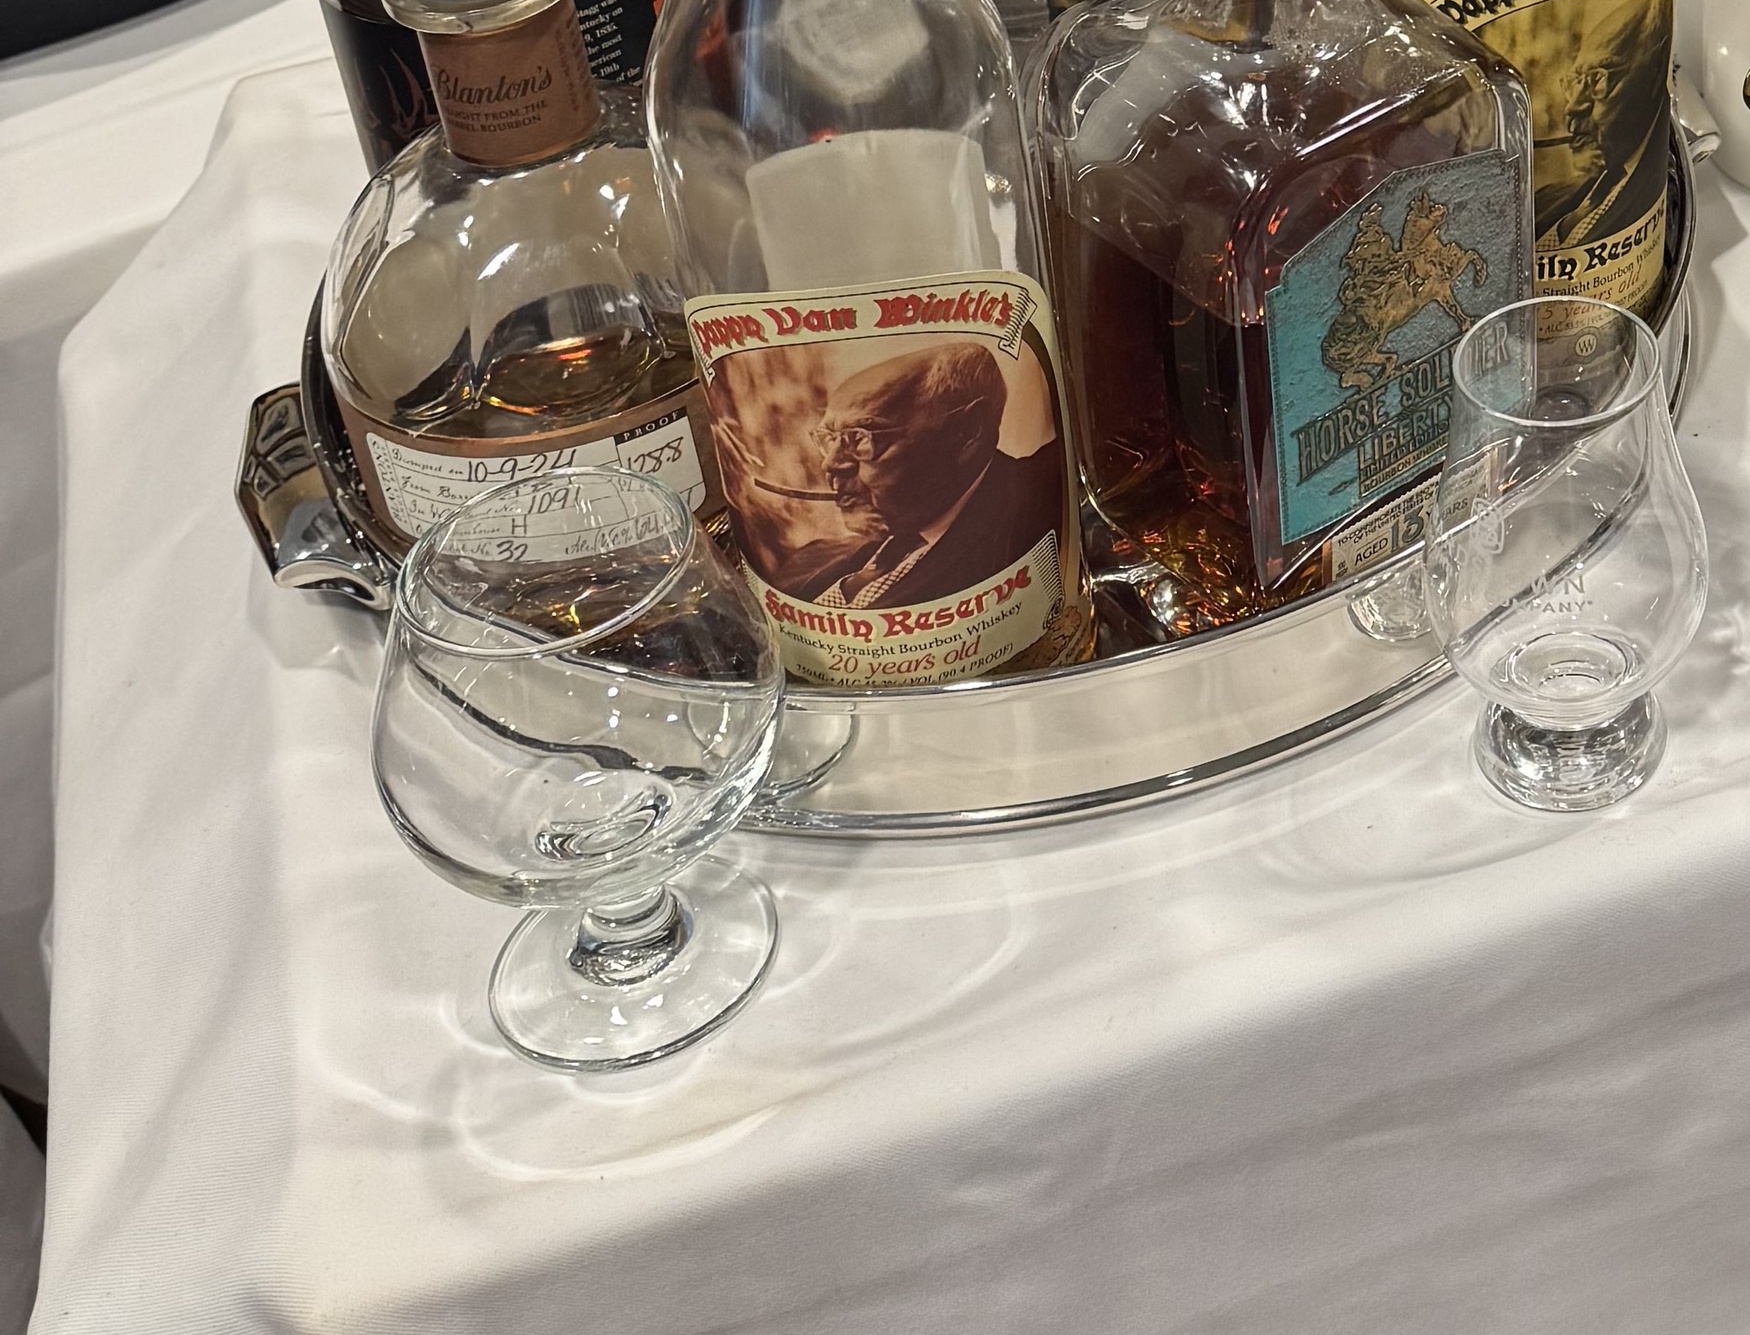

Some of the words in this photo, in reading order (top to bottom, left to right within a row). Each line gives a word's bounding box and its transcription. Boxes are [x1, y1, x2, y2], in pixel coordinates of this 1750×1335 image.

[579, 13, 610, 32] ntucky
[587, 46, 600, 55] he
[590, 49, 622, 67] erican
[430, 65, 553, 105] Blanton's
[480, 115, 542, 133] BOURBON
[483, 107, 520, 122] FROM
[522, 99, 549, 115] THE
[1536, 253, 1579, 281] ily
[1542, 280, 1590, 298] Straight
[1592, 261, 1635, 289] Bourbon
[1618, 265, 1643, 293] old
[762, 306, 858, 337] Van
[873, 289, 1014, 332] Winkle's
[623, 412, 680, 441] PROOF
[1297, 388, 1388, 482] HORSE
[1363, 456, 1412, 491] BOURBON
[510, 513, 528, 535] H
[1354, 537, 1389, 566] AGED
[1390, 505, 1425, 553] 13
[495, 540, 528, 562] 32
[765, 587, 875, 644] Family
[882, 565, 1032, 640] Reserve
[778, 622, 835, 654] Kentucky
[837, 643, 896, 661] Straight
[899, 631, 964, 654] Bourbon
[966, 600, 1023, 638] Whiskey
[827, 652, 859, 674] 20
[867, 652, 936, 680] years
[942, 634, 982, 664] old
[968, 641, 1014, 672] PROOF)
